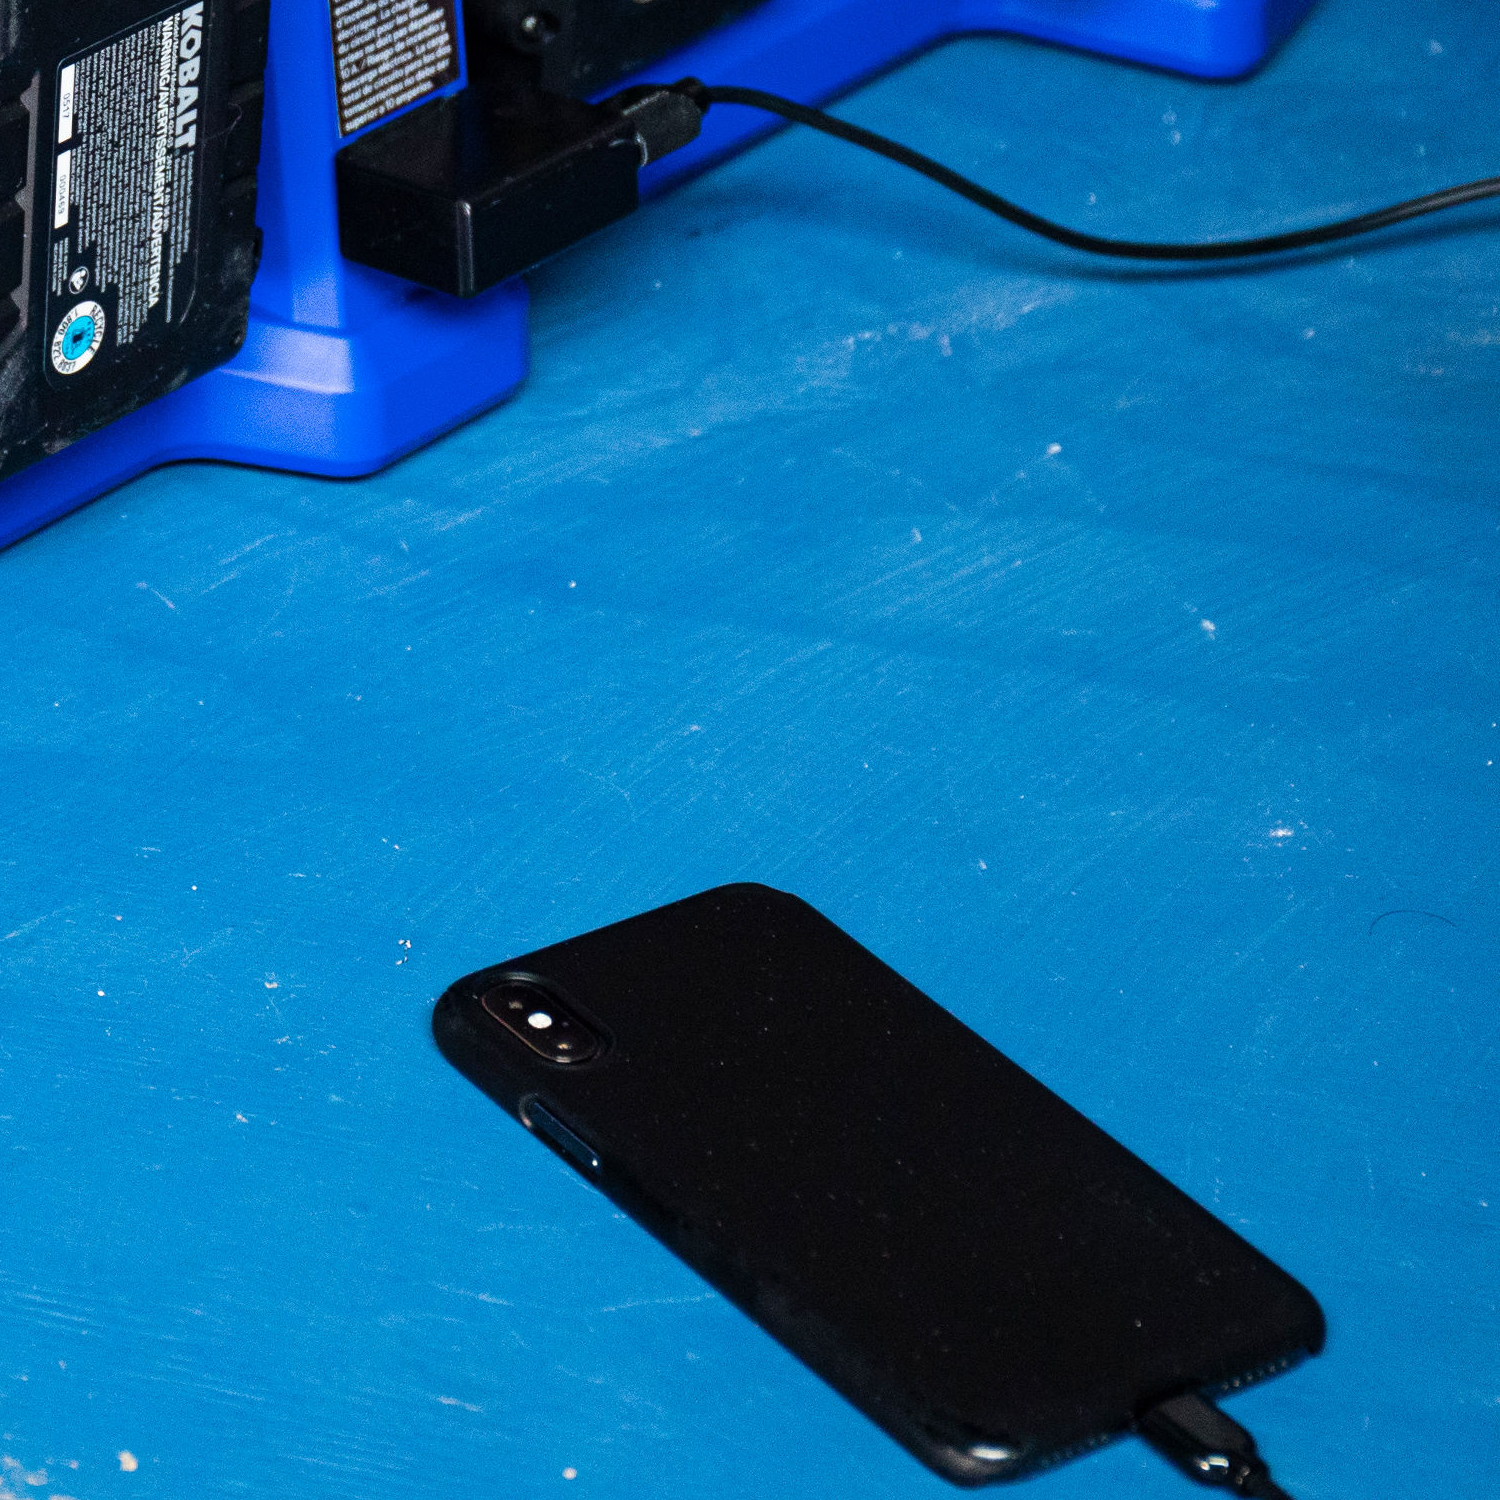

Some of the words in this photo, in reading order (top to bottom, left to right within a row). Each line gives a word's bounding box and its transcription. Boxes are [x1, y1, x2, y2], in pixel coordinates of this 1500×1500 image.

[62, 92, 70, 120] 0517
[174, 0, 203, 153] KOBALT
[148, 15, 173, 308] WARNING/AVERTISSEMENT/ADVERTENCIA
[90, 305, 103, 355] RECYCLE
